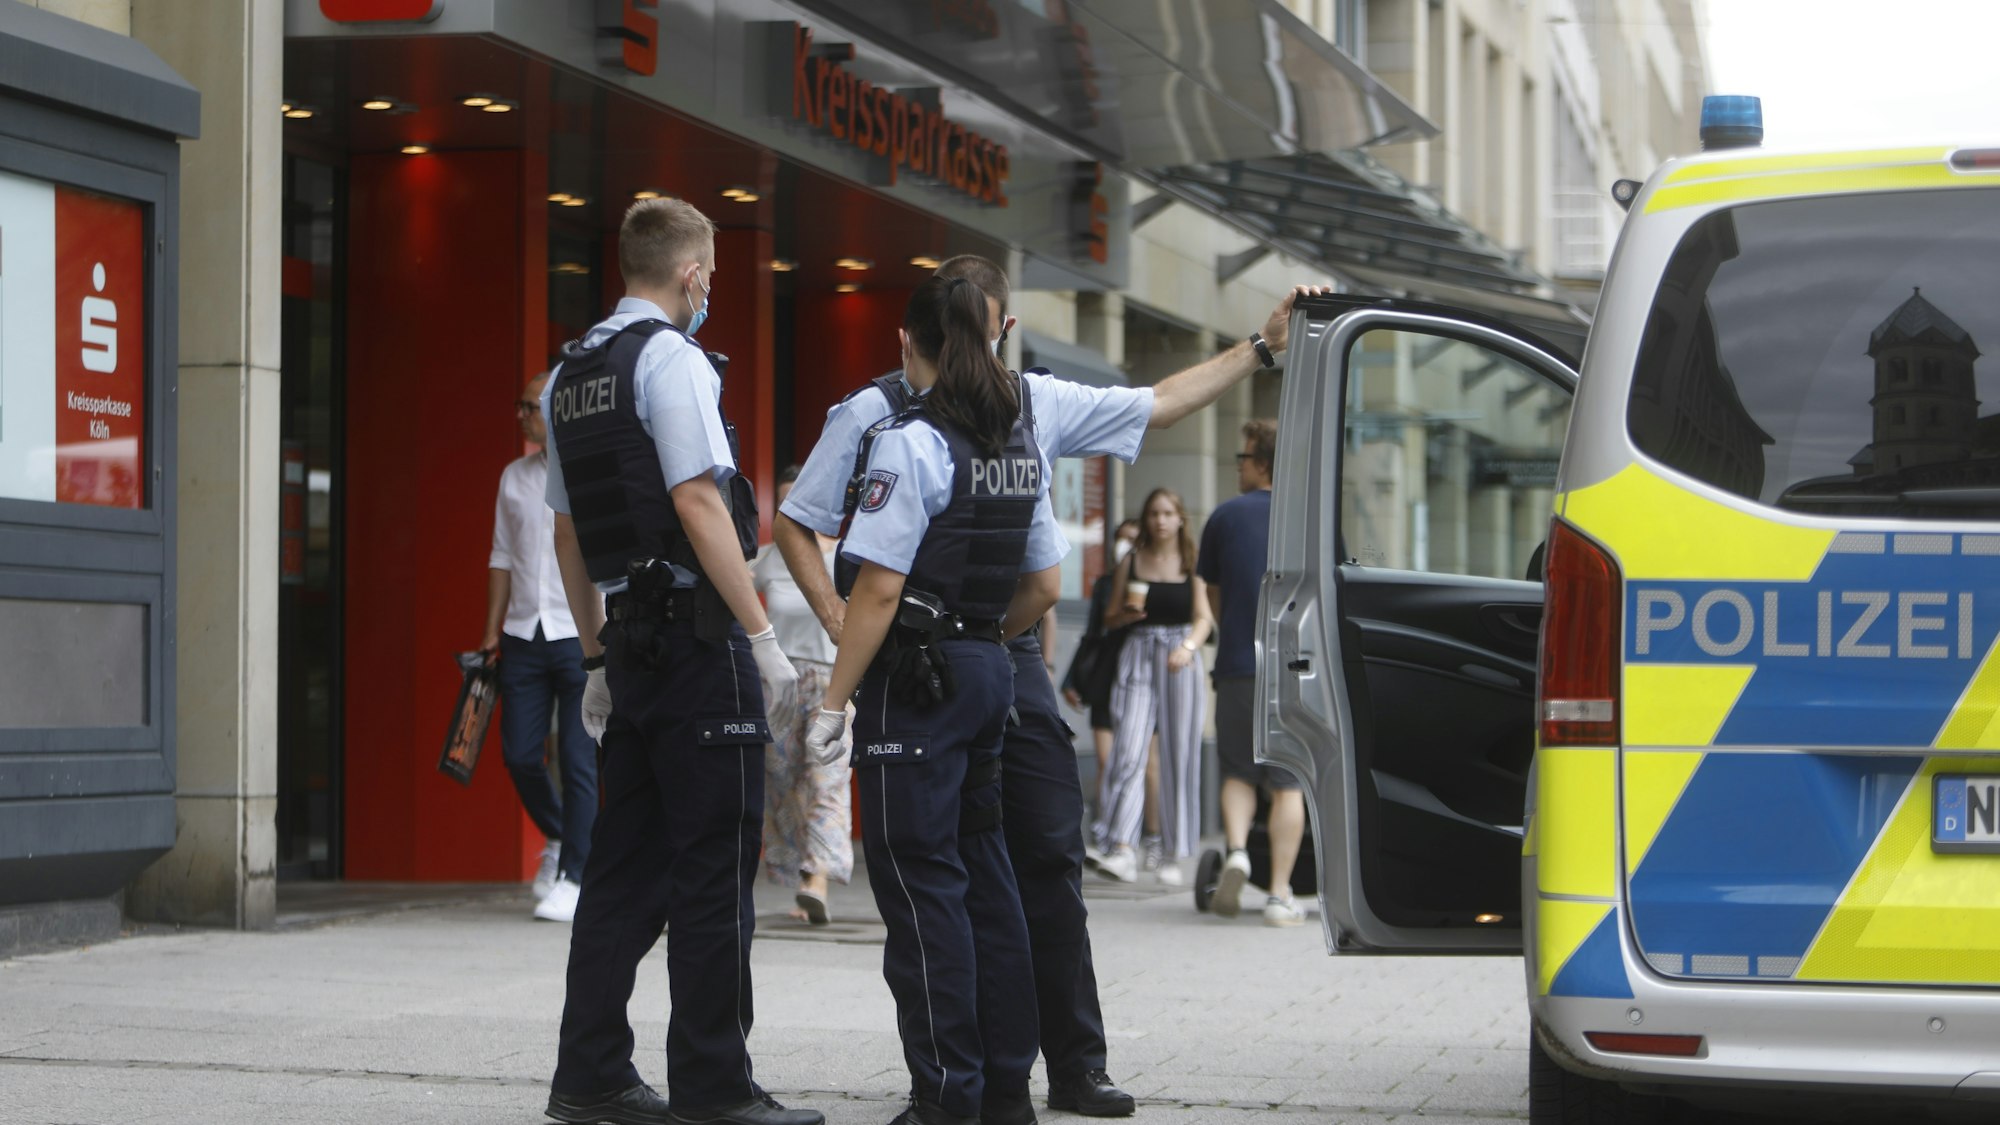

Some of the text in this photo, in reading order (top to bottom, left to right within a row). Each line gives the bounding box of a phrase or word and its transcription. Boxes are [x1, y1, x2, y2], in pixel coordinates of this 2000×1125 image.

[793, 20, 1009, 208] Kreissparkasse
[67, 390, 132, 418] Kreissparkasse
[554, 375, 617, 427] POLIZEI
[90, 419, 110, 440] Köln
[1635, 589, 1973, 659] POLIZEI
[723, 723, 756, 735] POLIZEI
[867, 743, 903, 756] POLIZEI
[1945, 817, 1957, 831] D
[1967, 785, 2000, 835] N
